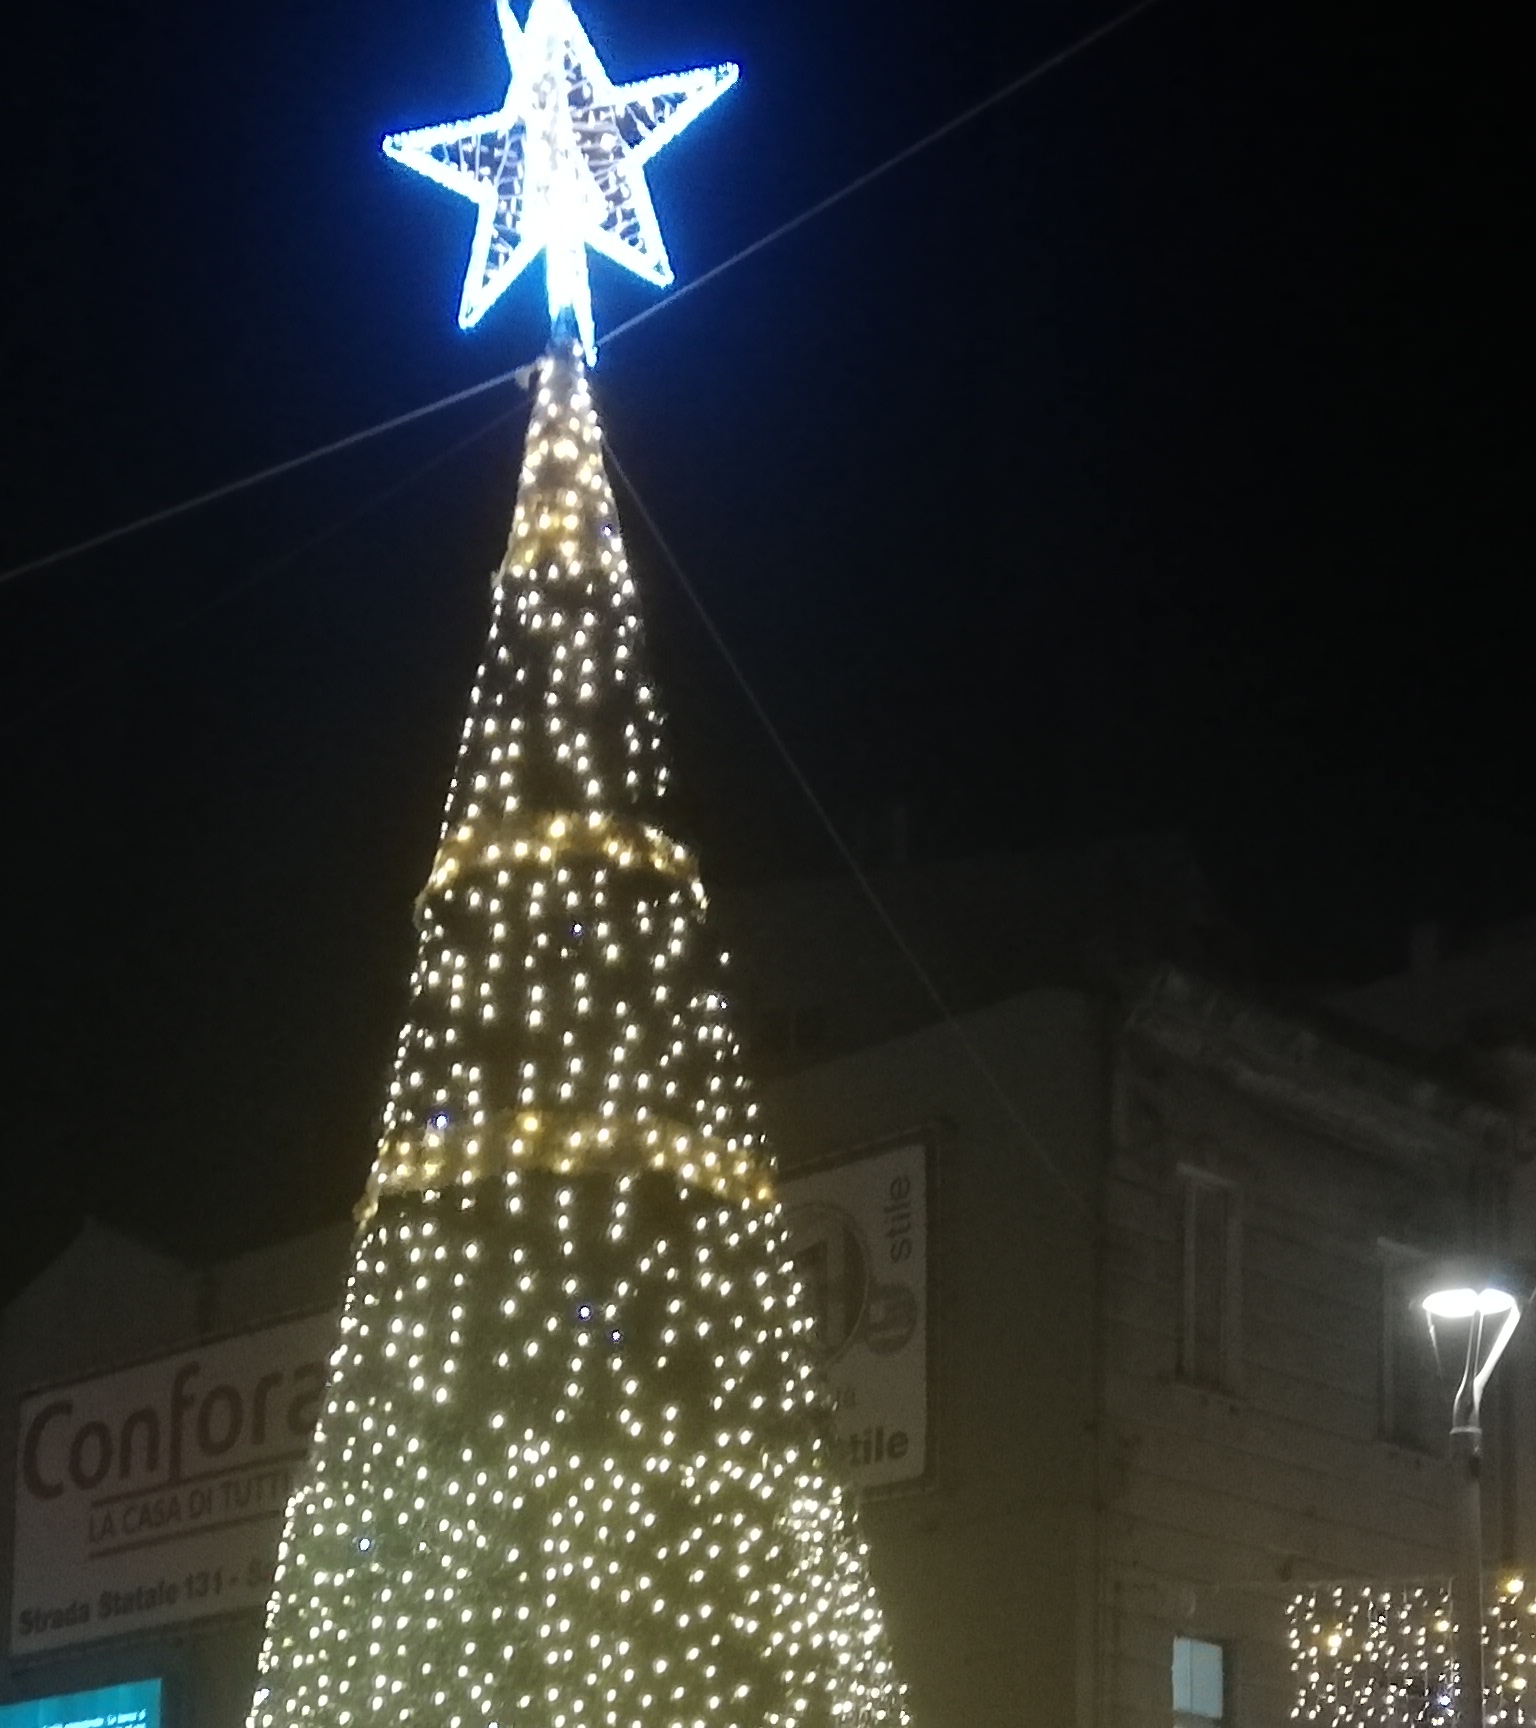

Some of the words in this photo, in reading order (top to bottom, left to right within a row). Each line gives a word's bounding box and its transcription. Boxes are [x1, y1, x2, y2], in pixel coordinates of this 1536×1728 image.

[87, 1510, 116, 1543] LA
[121, 1497, 182, 1535] CASA
[188, 1489, 212, 1520] DI
[18, 1600, 90, 1637] Strada
[98, 1578, 179, 1620] Statale
[183, 1567, 223, 1600] 131
